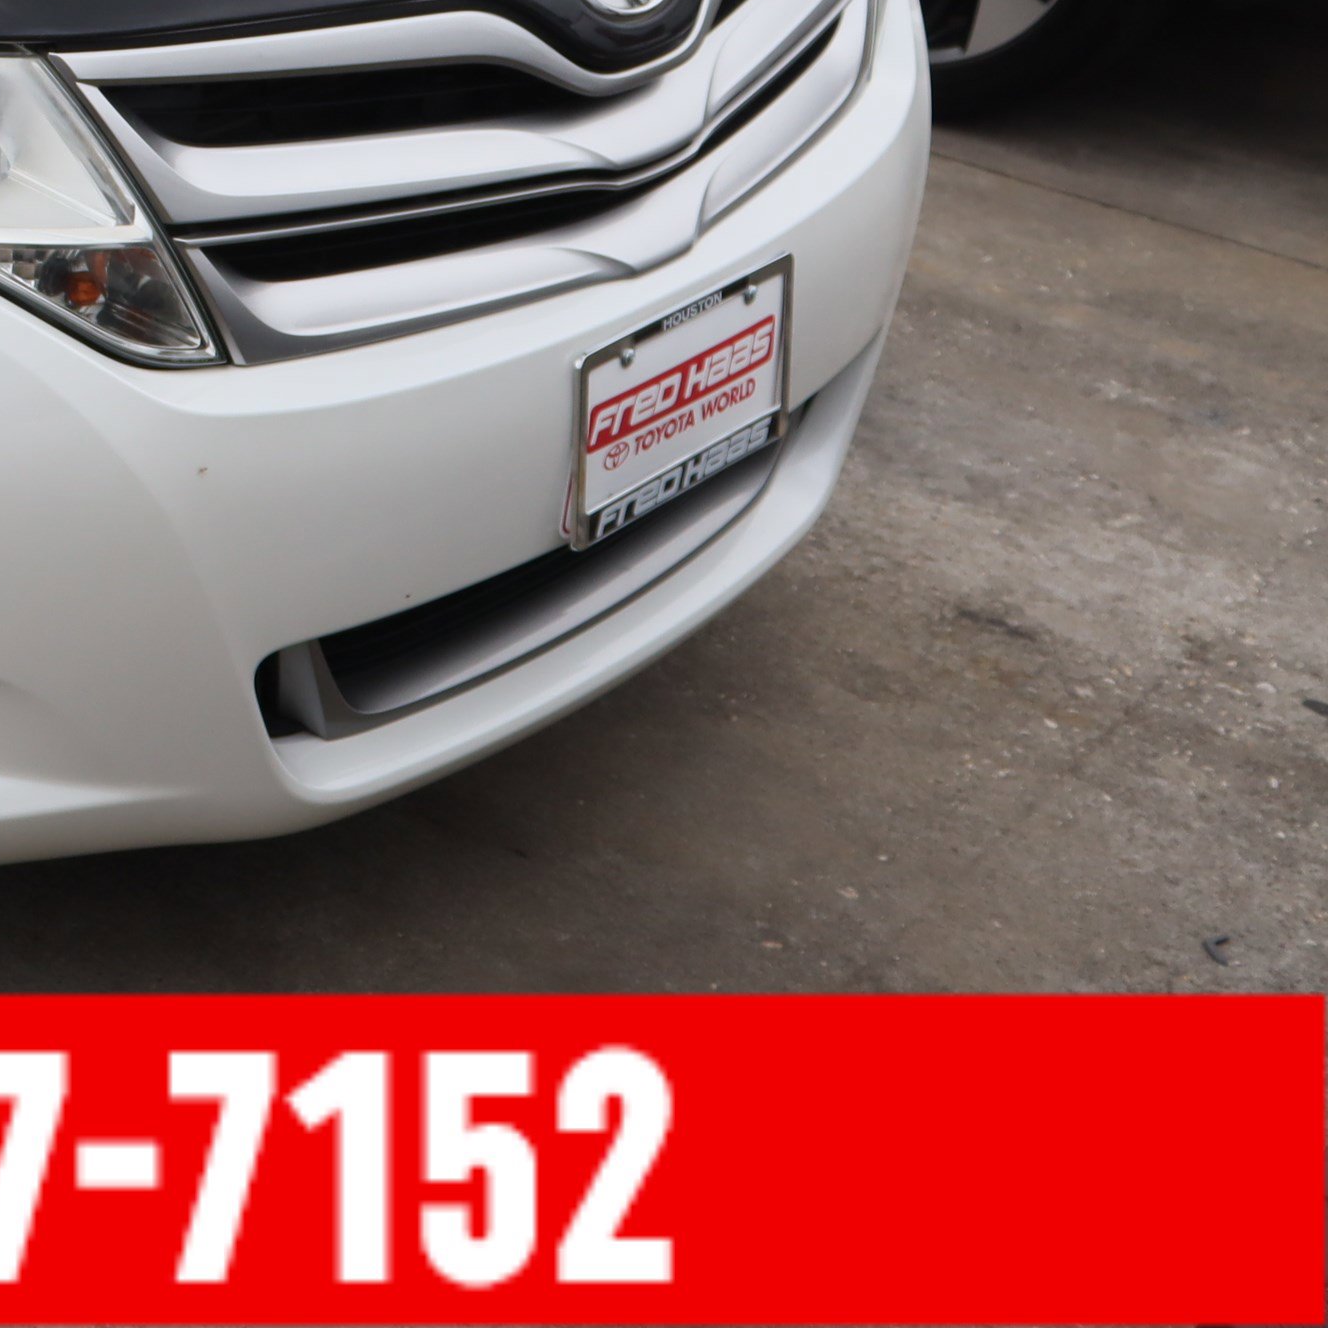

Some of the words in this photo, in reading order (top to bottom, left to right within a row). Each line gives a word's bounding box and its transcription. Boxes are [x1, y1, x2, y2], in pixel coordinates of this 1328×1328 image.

[662, 290, 724, 332] HOUSTON
[634, 409, 695, 457] TOYOTA
[701, 377, 757, 420] WORLD
